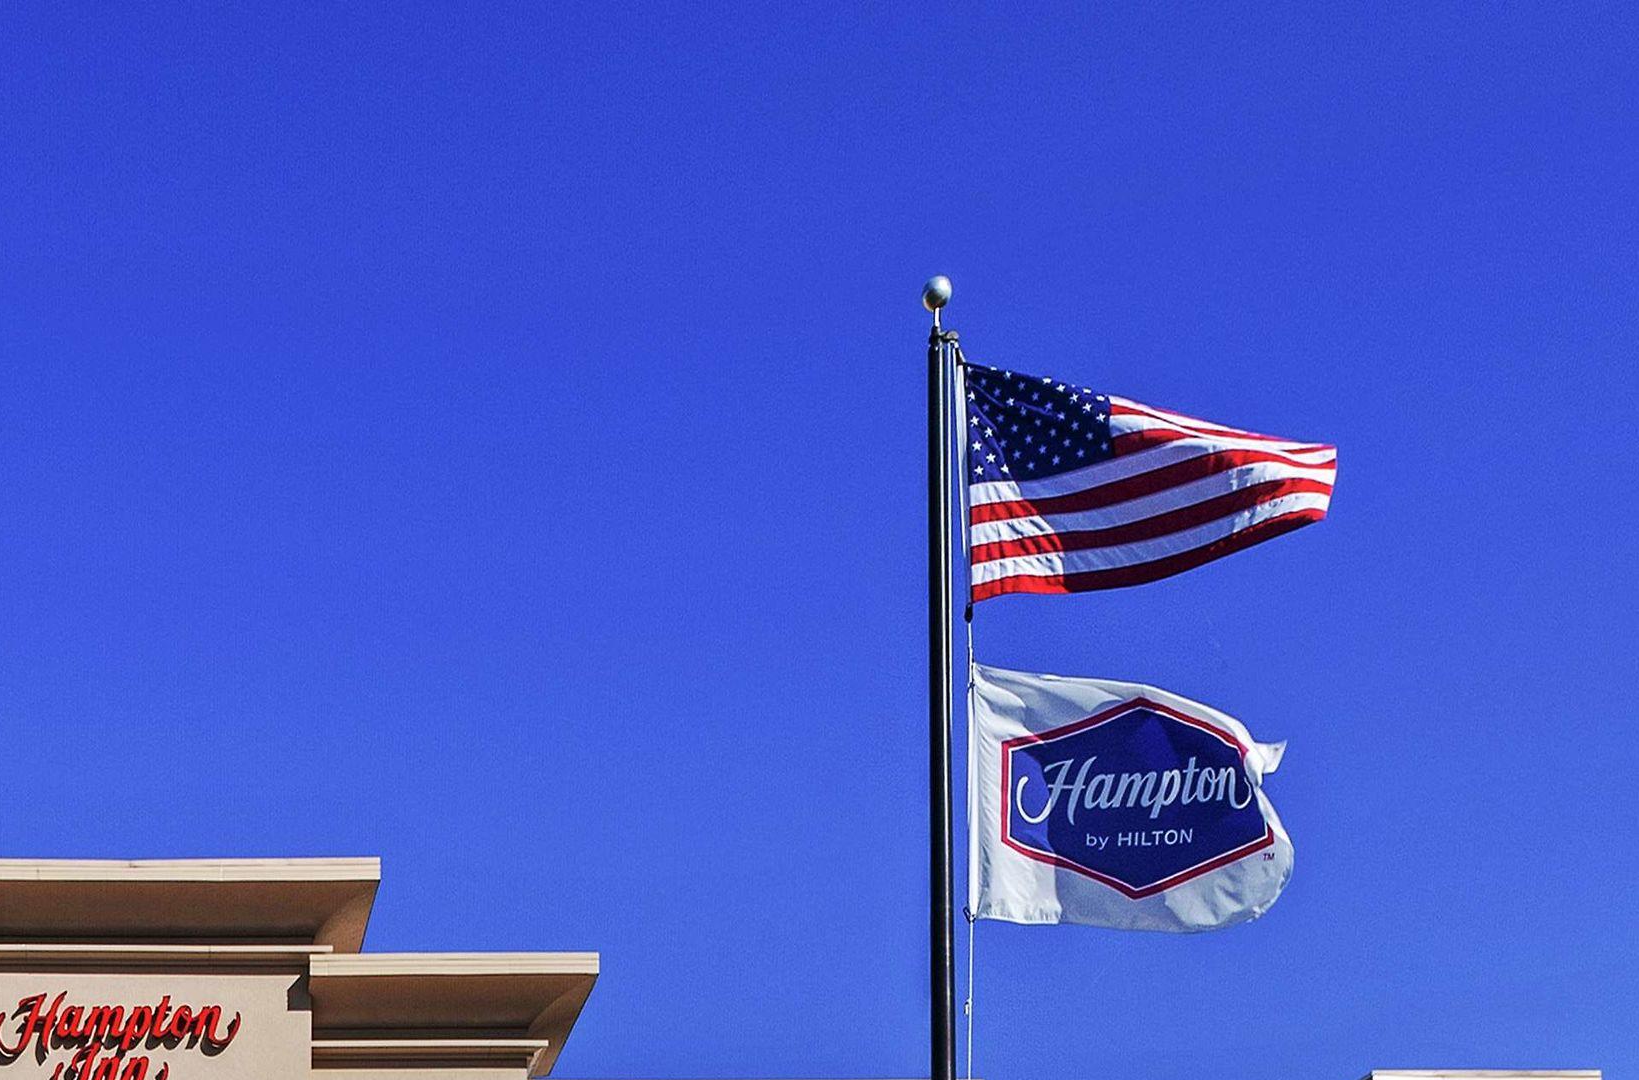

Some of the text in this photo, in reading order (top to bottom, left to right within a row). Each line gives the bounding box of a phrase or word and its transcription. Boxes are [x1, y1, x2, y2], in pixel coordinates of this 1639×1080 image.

[1016, 756, 1251, 825] Hampton
[1086, 828, 1193, 850] by HILTON
